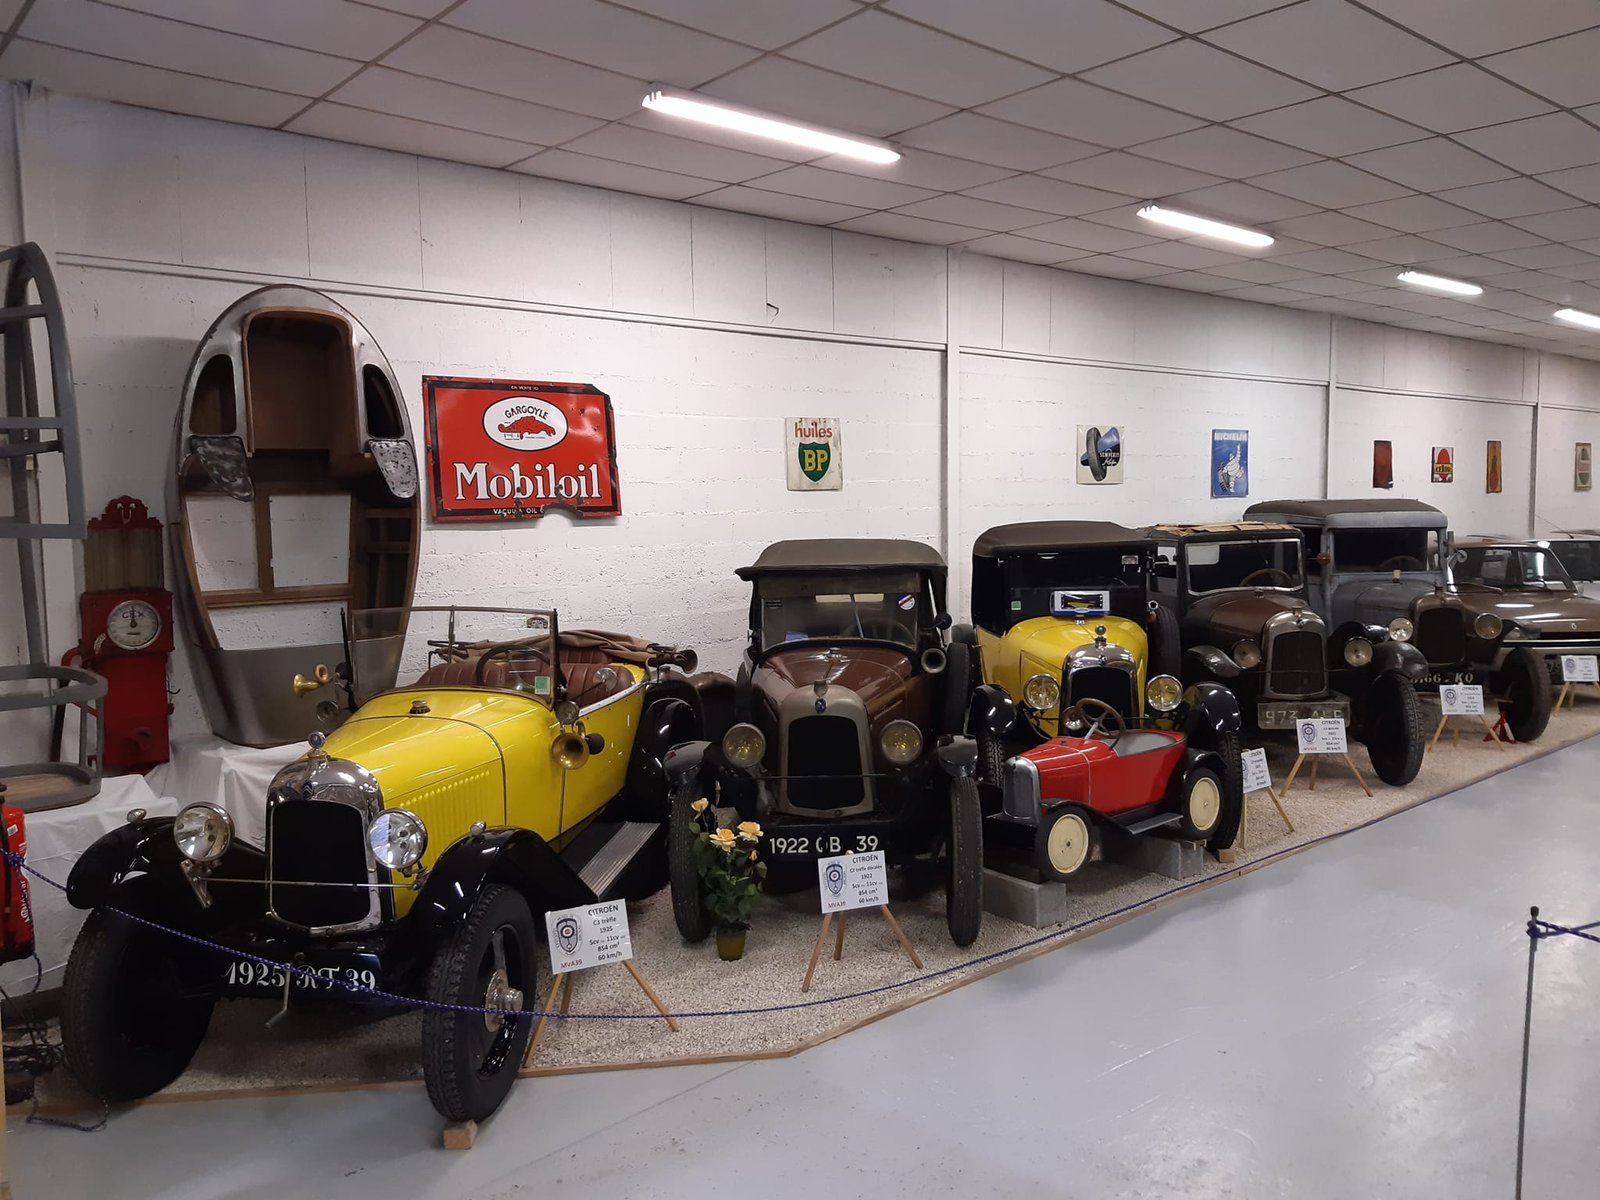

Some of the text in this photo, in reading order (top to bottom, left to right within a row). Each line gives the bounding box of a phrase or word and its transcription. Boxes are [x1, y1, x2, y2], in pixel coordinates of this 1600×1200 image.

[504, 405, 549, 420] GARGOYLE
[794, 421, 833, 438] huiles
[1214, 432, 1248, 440] MICHELIN
[803, 449, 828, 472] BP
[453, 462, 602, 500] Mobiloil
[1455, 672, 1474, 684] KQ
[1265, 710, 1298, 724] 973
[769, 837, 809, 854] 1922
[856, 835, 879, 851] 39
[852, 854, 879, 863] CITROËN
[600, 926, 614, 934] 1925
[606, 951, 623, 959] km/h
[560, 959, 583, 969] MVA39
[222, 961, 286, 987] 1925
[345, 968, 376, 992] 39
